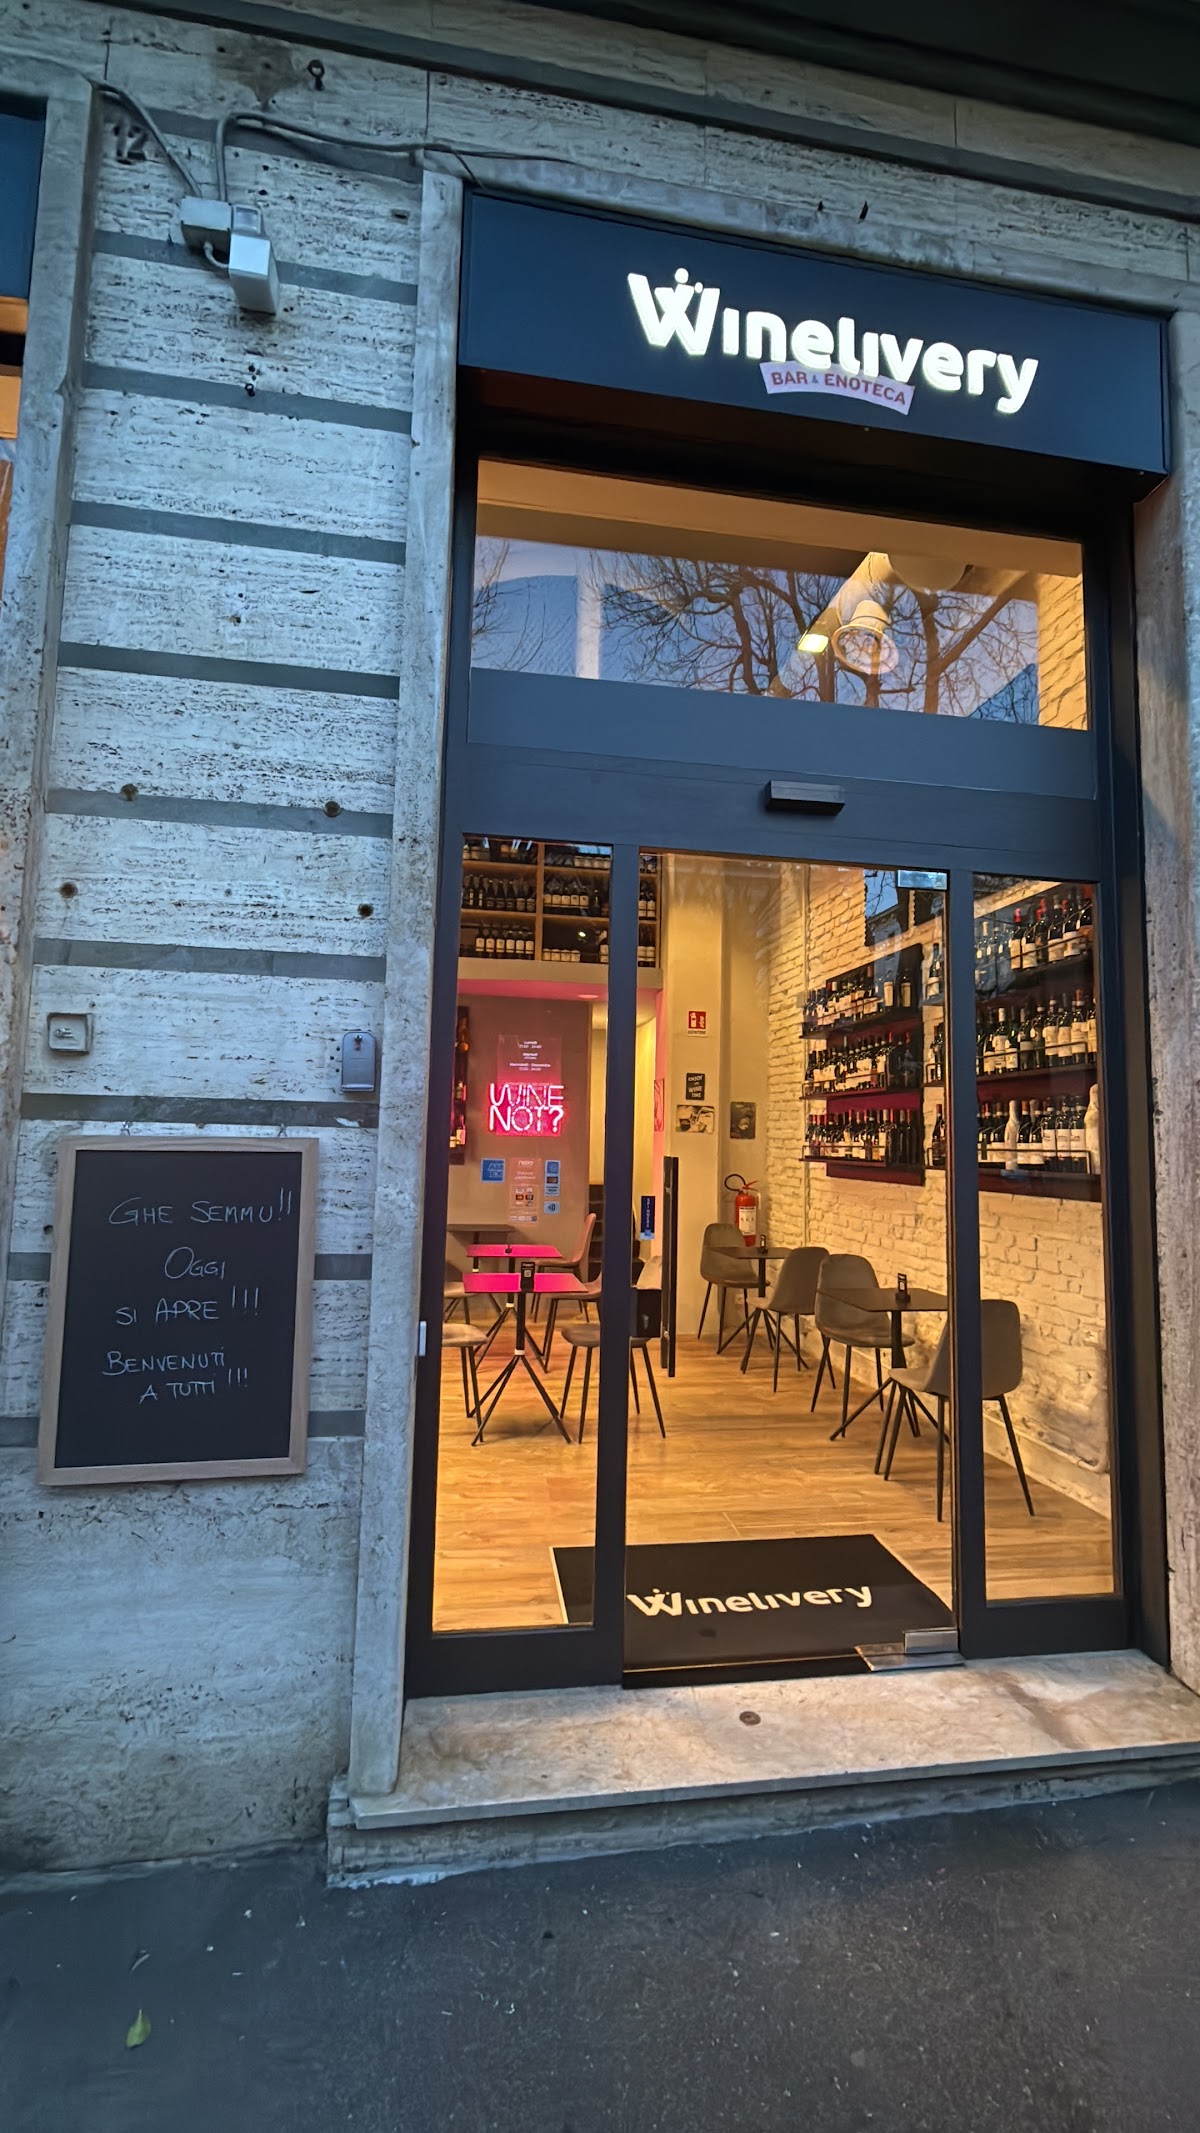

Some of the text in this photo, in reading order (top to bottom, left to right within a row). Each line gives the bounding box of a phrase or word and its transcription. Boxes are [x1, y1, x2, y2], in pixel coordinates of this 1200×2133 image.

[627, 268, 1039, 414] Winelivery
[771, 371, 808, 385] BAR
[824, 373, 906, 406] ENOTECA
[489, 1083, 565, 1107] WINE
[489, 1105, 565, 1133] NOT?
[108, 1197, 173, 1227] GHE
[164, 1246, 226, 1280] OGGI
[116, 1307, 138, 1326] SI
[155, 1298, 220, 1324] APRE
[101, 1346, 225, 1376] BENVENUTI
[138, 1384, 159, 1405] A
[165, 1380, 215, 1398] TUTTI
[626, 1586, 873, 1617] Winelivery
